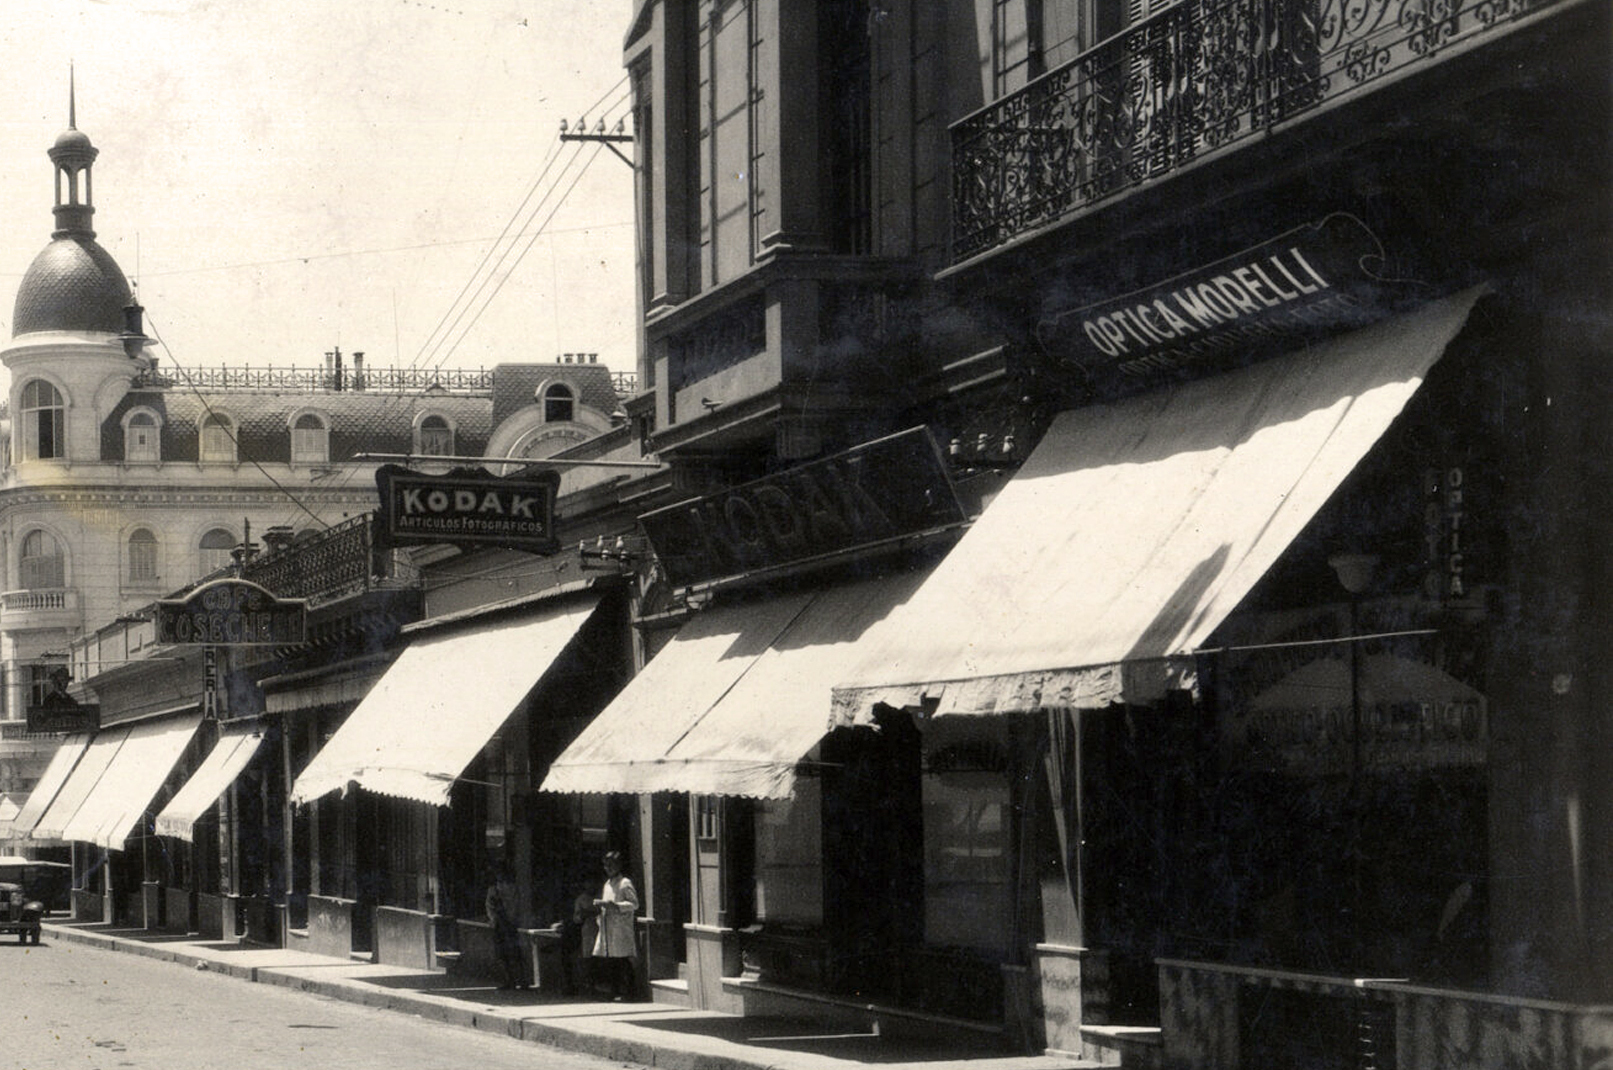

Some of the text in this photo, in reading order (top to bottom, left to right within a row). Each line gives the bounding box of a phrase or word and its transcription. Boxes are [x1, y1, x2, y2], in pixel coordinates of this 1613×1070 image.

[1083, 247, 1330, 357] OPTICA MORELLI
[403, 488, 538, 518] KODAK
[690, 457, 896, 563] KODAK
[1448, 467, 1464, 595] OPTICA
[205, 646, 215, 718] RERIA
